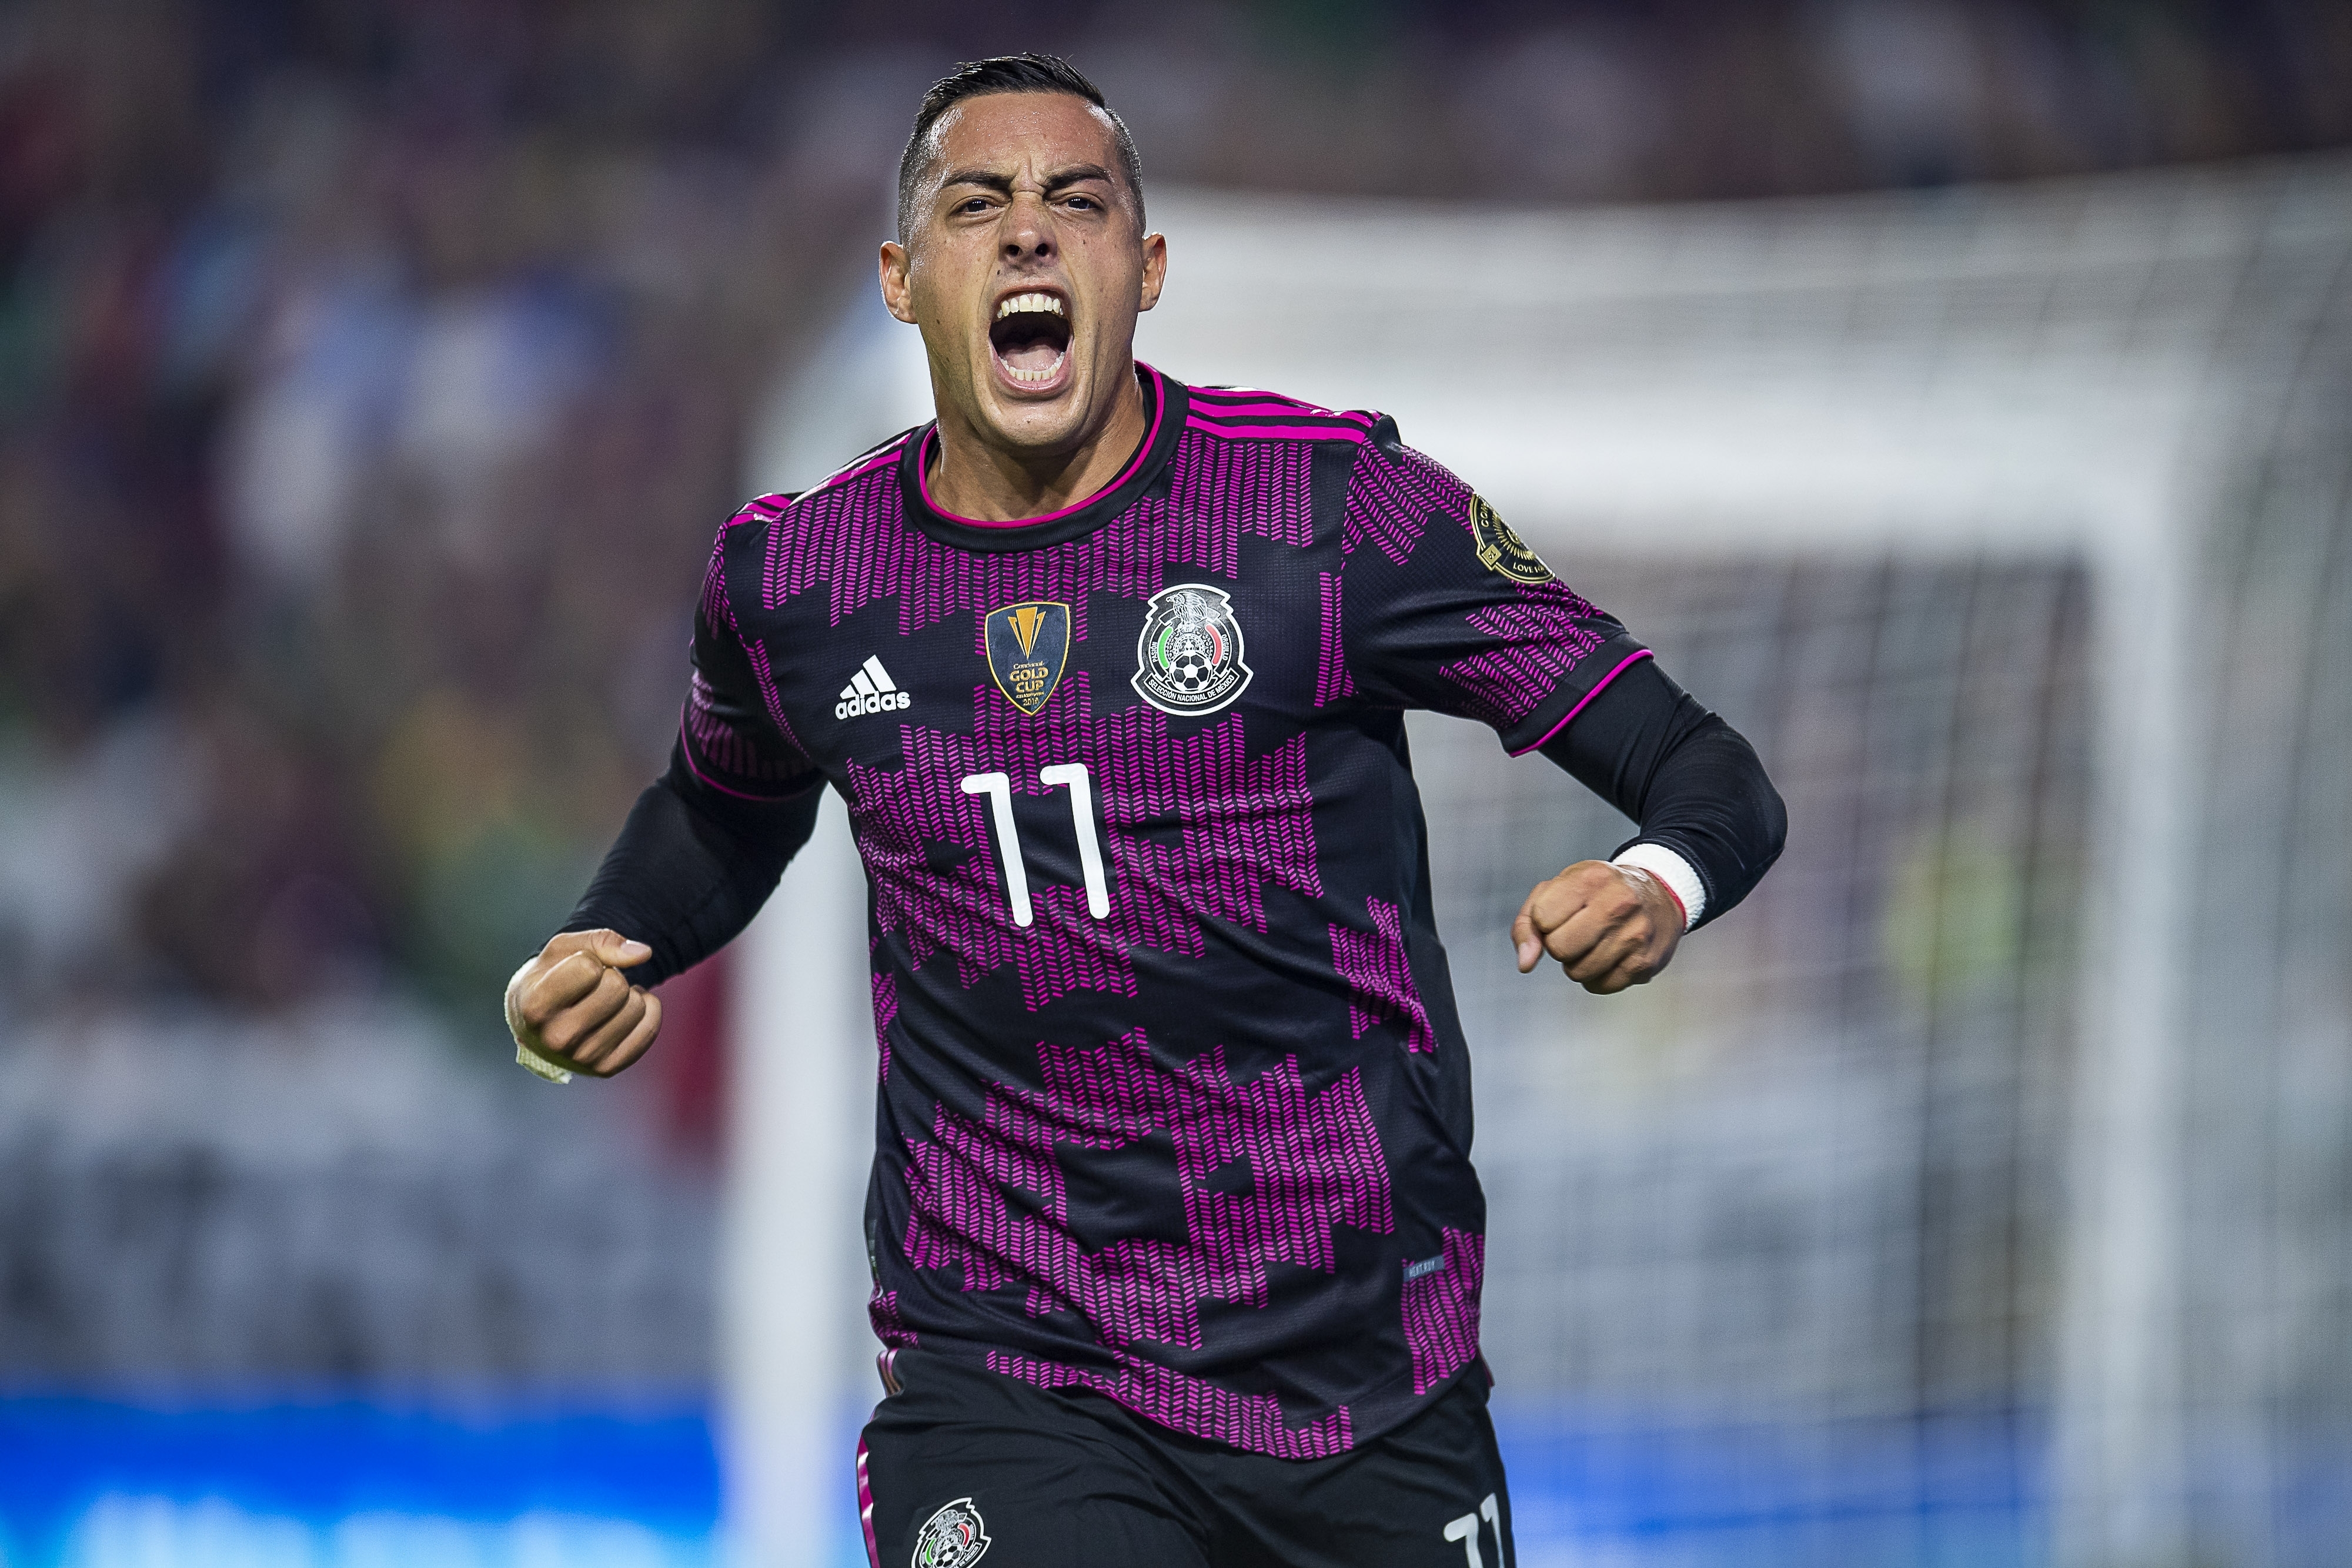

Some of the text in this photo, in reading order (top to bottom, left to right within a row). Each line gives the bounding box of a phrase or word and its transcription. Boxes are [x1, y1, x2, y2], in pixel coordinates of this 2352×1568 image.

[1221, 634, 1230, 661] ORGULLO
[1010, 667, 1048, 681] GOLD
[1015, 680, 1044, 693] CUP
[1148, 674, 1235, 702] SELECCIÓN NACIONAL DE MÉXICO
[835, 690, 911, 720] adidas
[960, 763, 1111, 928] 11
